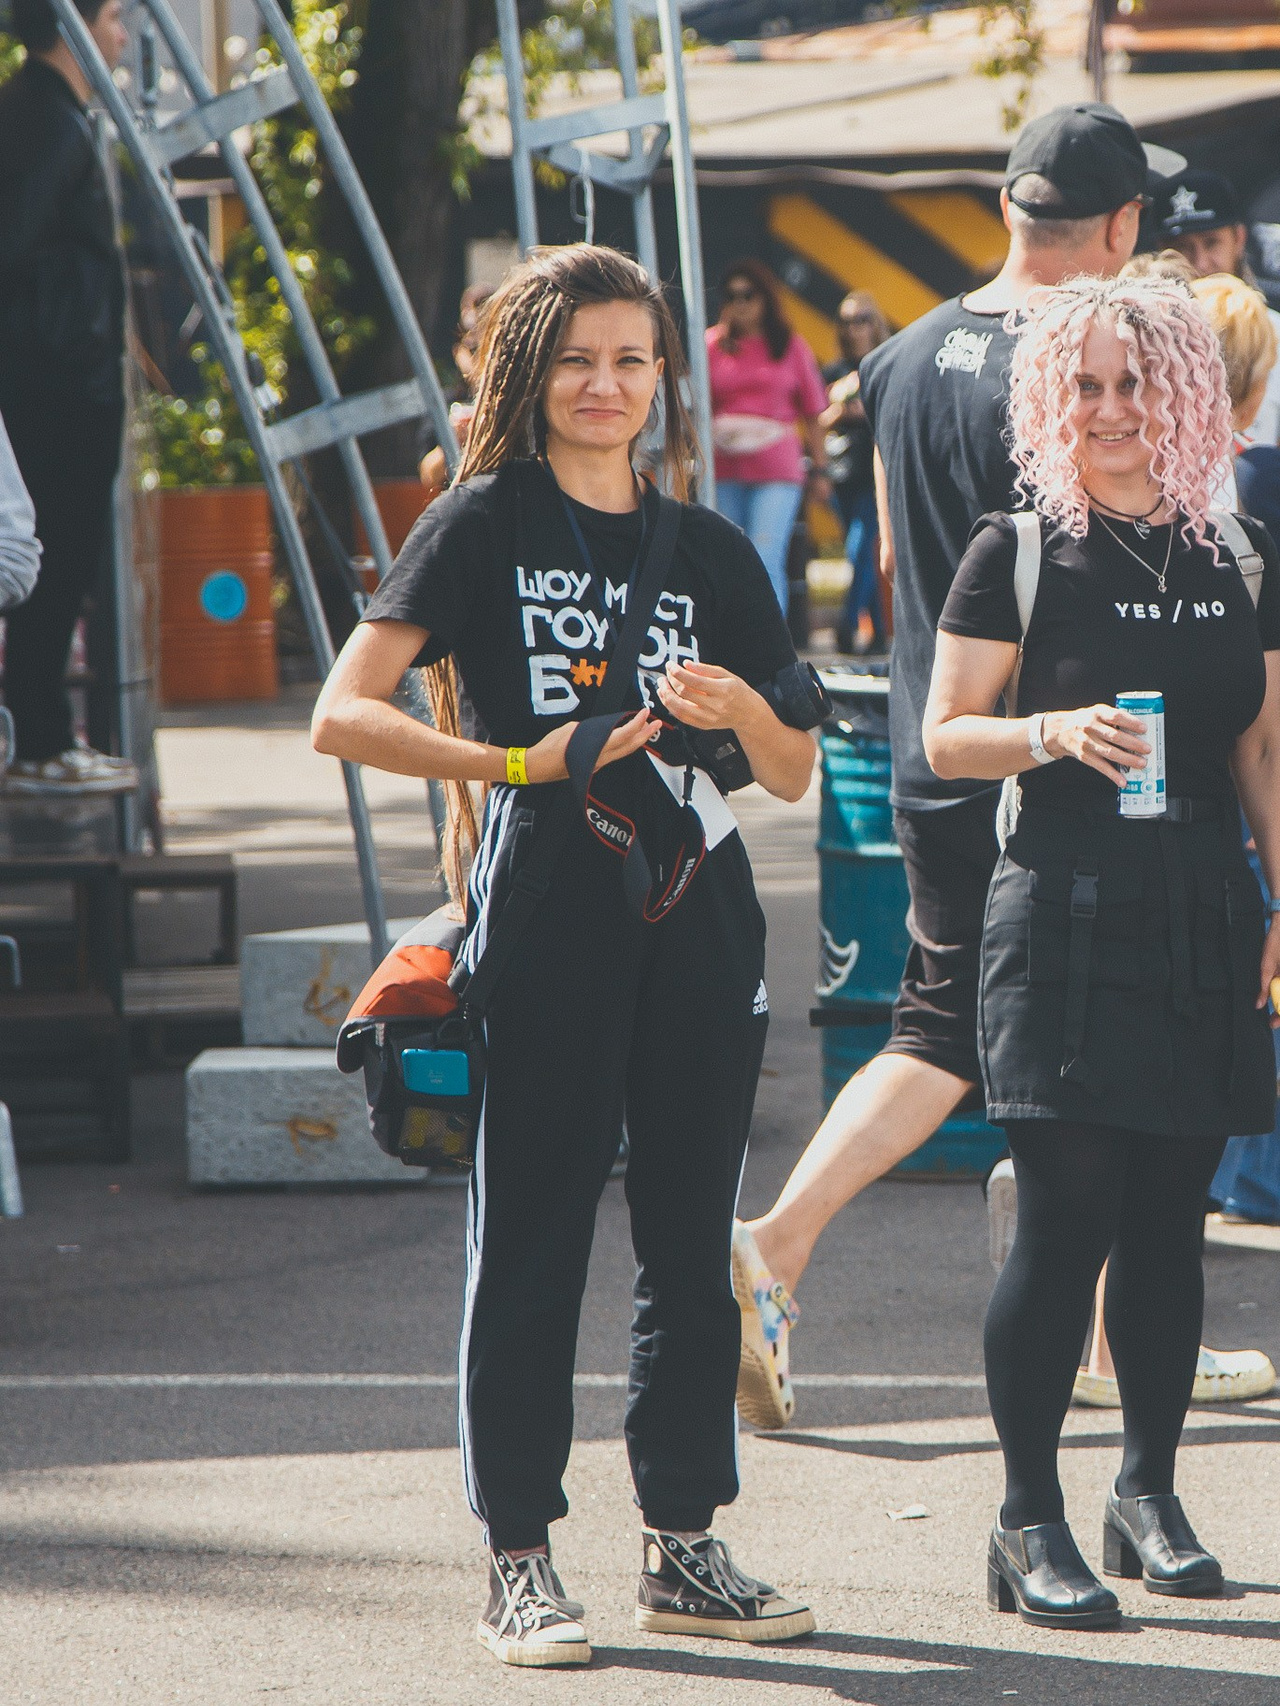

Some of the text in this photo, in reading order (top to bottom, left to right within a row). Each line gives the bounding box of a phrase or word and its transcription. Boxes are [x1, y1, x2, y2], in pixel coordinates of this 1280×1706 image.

[516, 565, 696, 628] ШОУ МСТ
[1115, 601, 1161, 619] YES
[1193, 600, 1226, 618] NO
[522, 604, 609, 651] ГОУ
